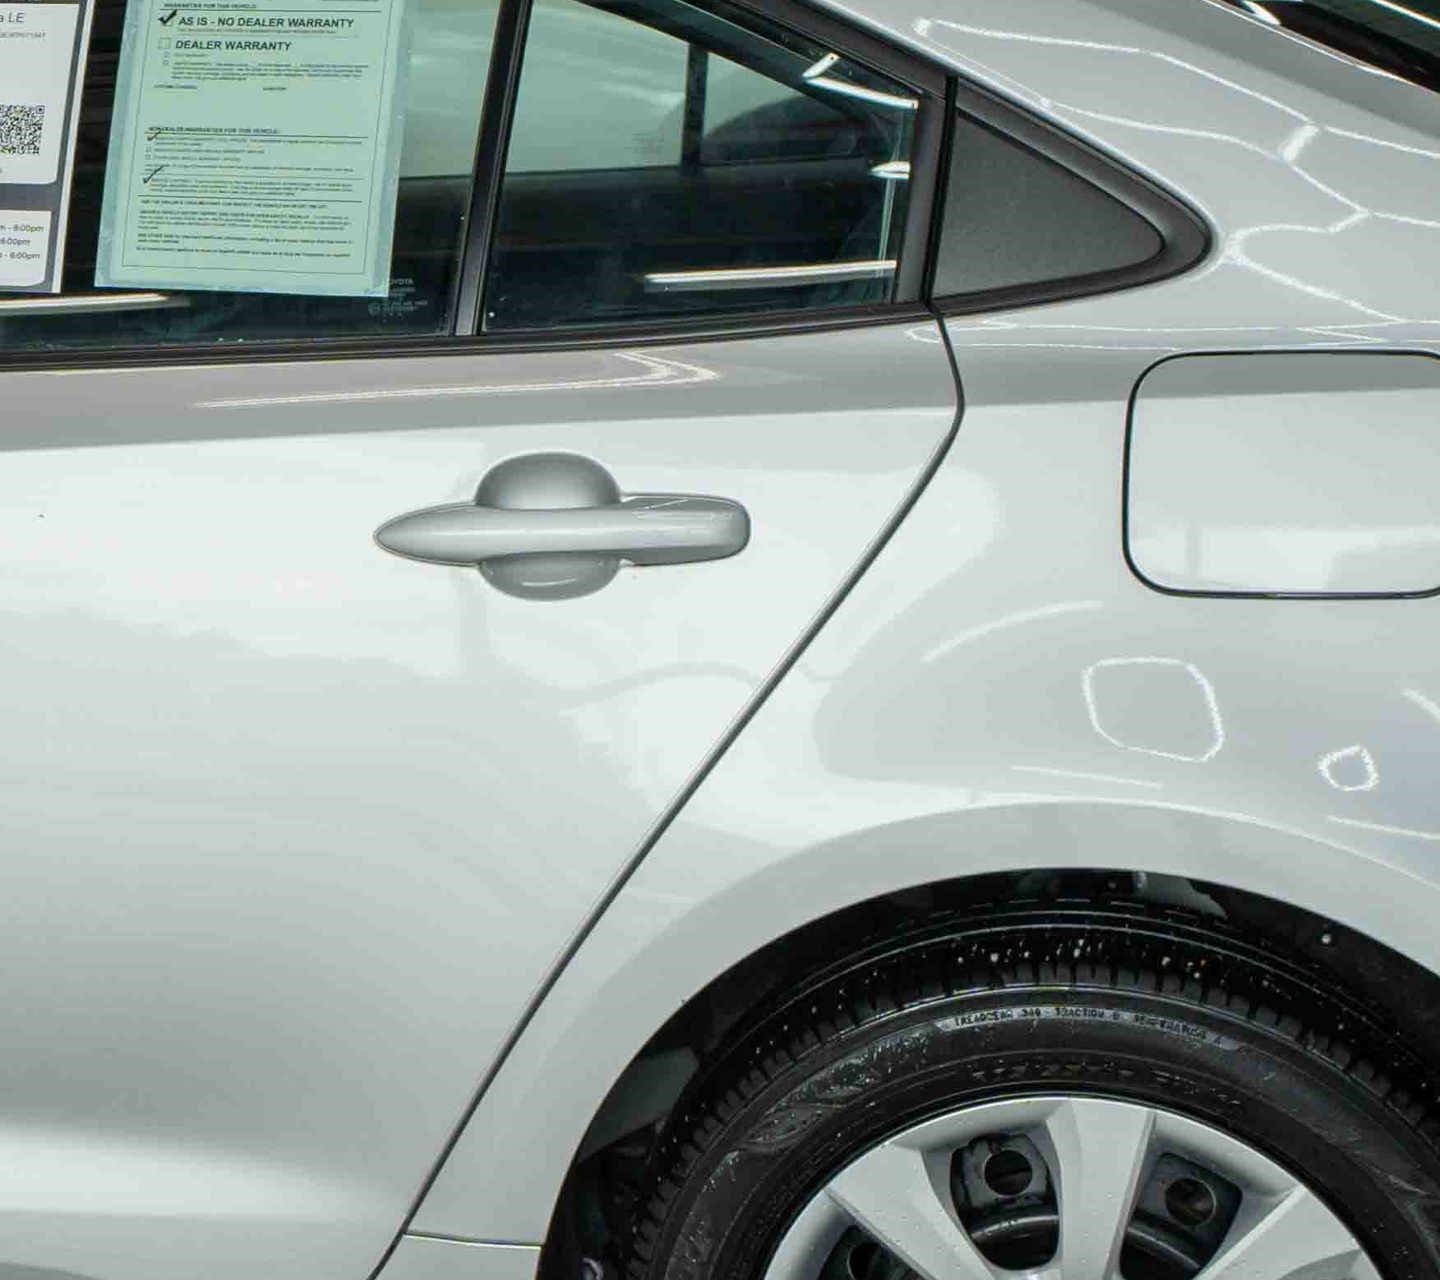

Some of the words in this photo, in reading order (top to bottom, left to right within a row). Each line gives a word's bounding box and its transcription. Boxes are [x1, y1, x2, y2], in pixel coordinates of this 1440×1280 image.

[8, 12, 25, 24] LE
[178, 17, 194, 26] AS
[196, 17, 208, 26] IS
[217, 18, 235, 27] NO
[237, 18, 284, 27] DEALER
[287, 18, 355, 28] WARRANTY
[175, 40, 221, 49] DEALER
[224, 41, 292, 51] WARRANTY
